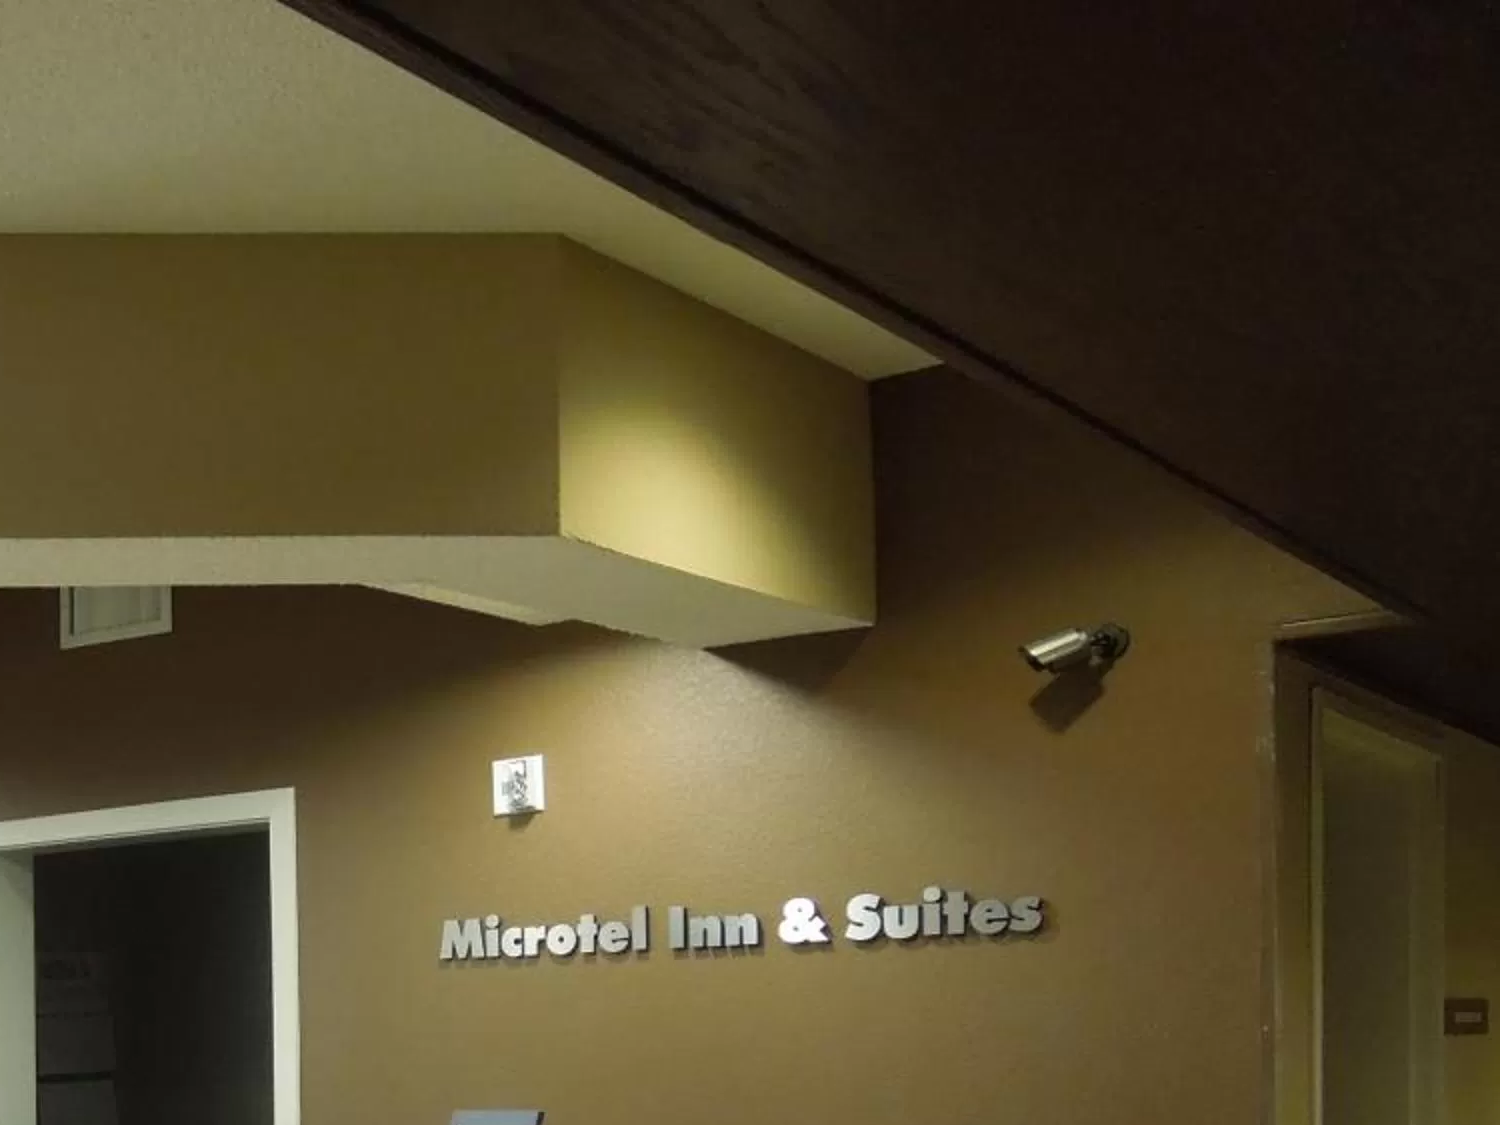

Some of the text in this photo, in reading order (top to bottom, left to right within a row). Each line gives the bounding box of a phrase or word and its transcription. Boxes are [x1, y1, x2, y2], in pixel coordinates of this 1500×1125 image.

[440, 886, 1043, 960] Microtel Inn & Suites
